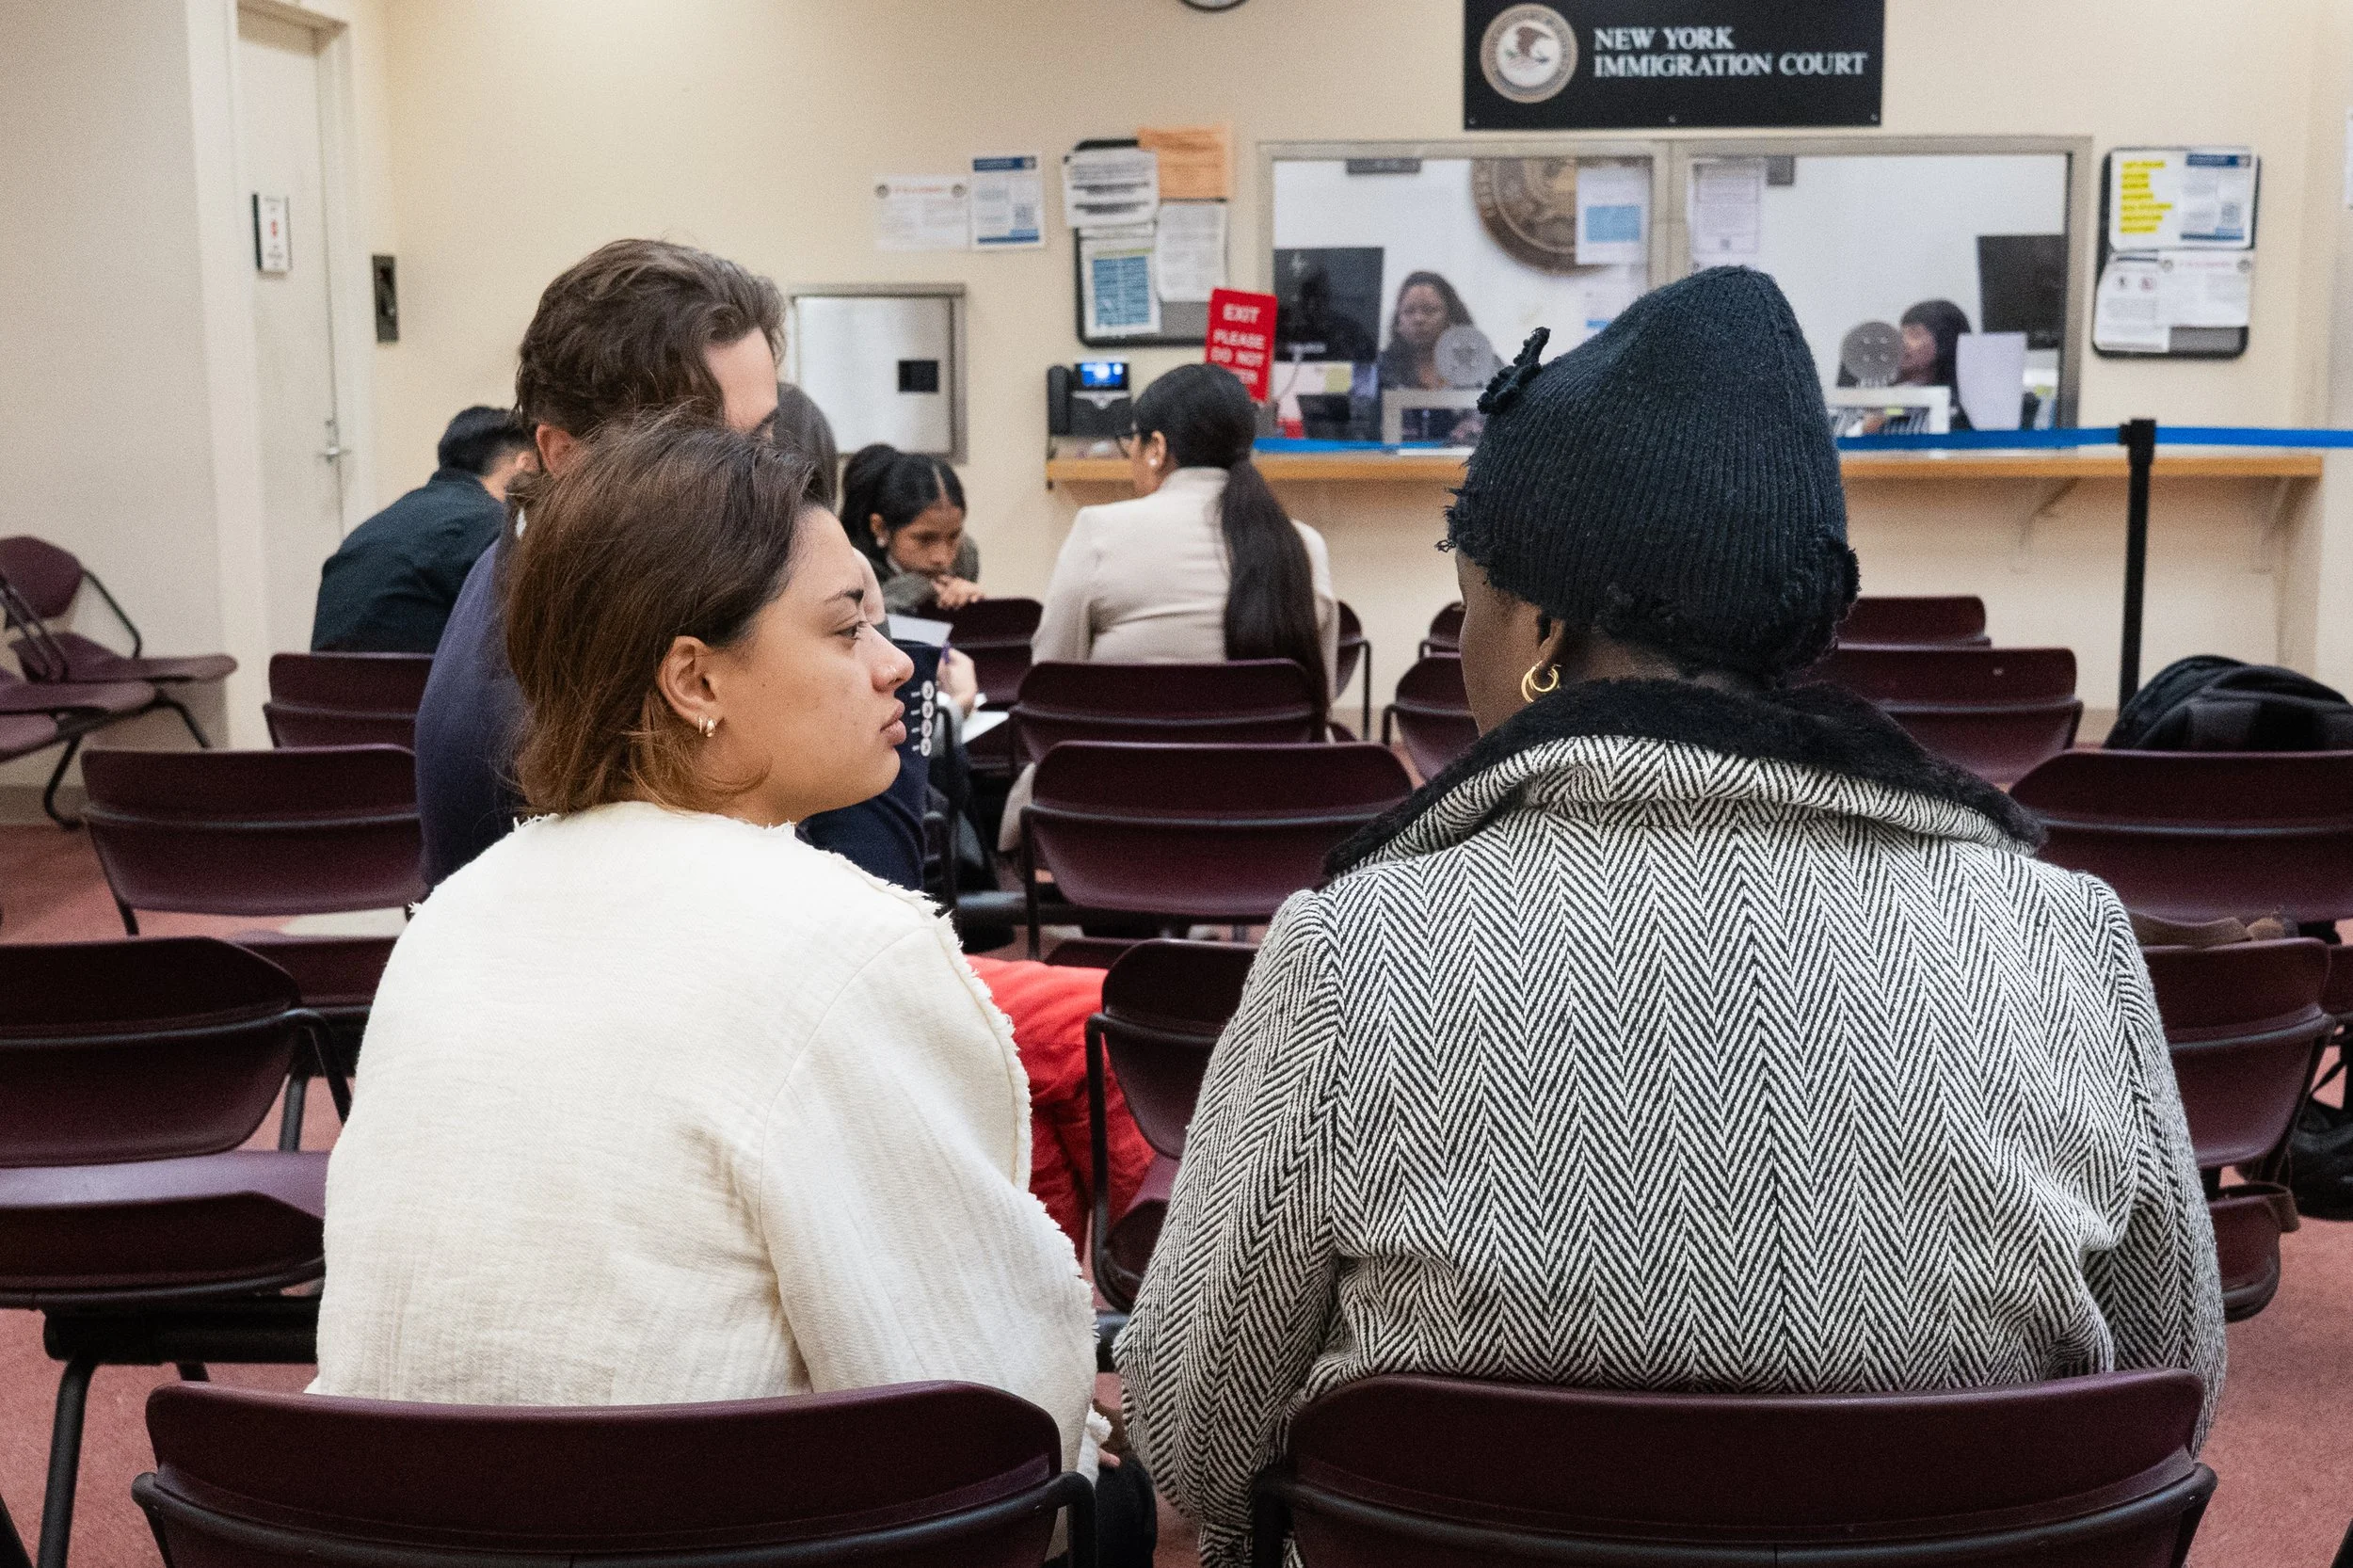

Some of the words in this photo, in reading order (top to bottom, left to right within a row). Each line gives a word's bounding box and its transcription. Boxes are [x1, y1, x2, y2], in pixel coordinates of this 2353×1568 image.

[1594, 26, 1656, 51] NEW
[1662, 26, 1735, 50] YORK
[1594, 53, 1772, 77] IMMIGRATION
[1779, 52, 1868, 75] COURT
[1223, 303, 1259, 324] EXIT
[1212, 328, 1265, 349] PLEASE
[1210, 346, 1232, 363] DO
[1235, 349, 1265, 367] NOT
